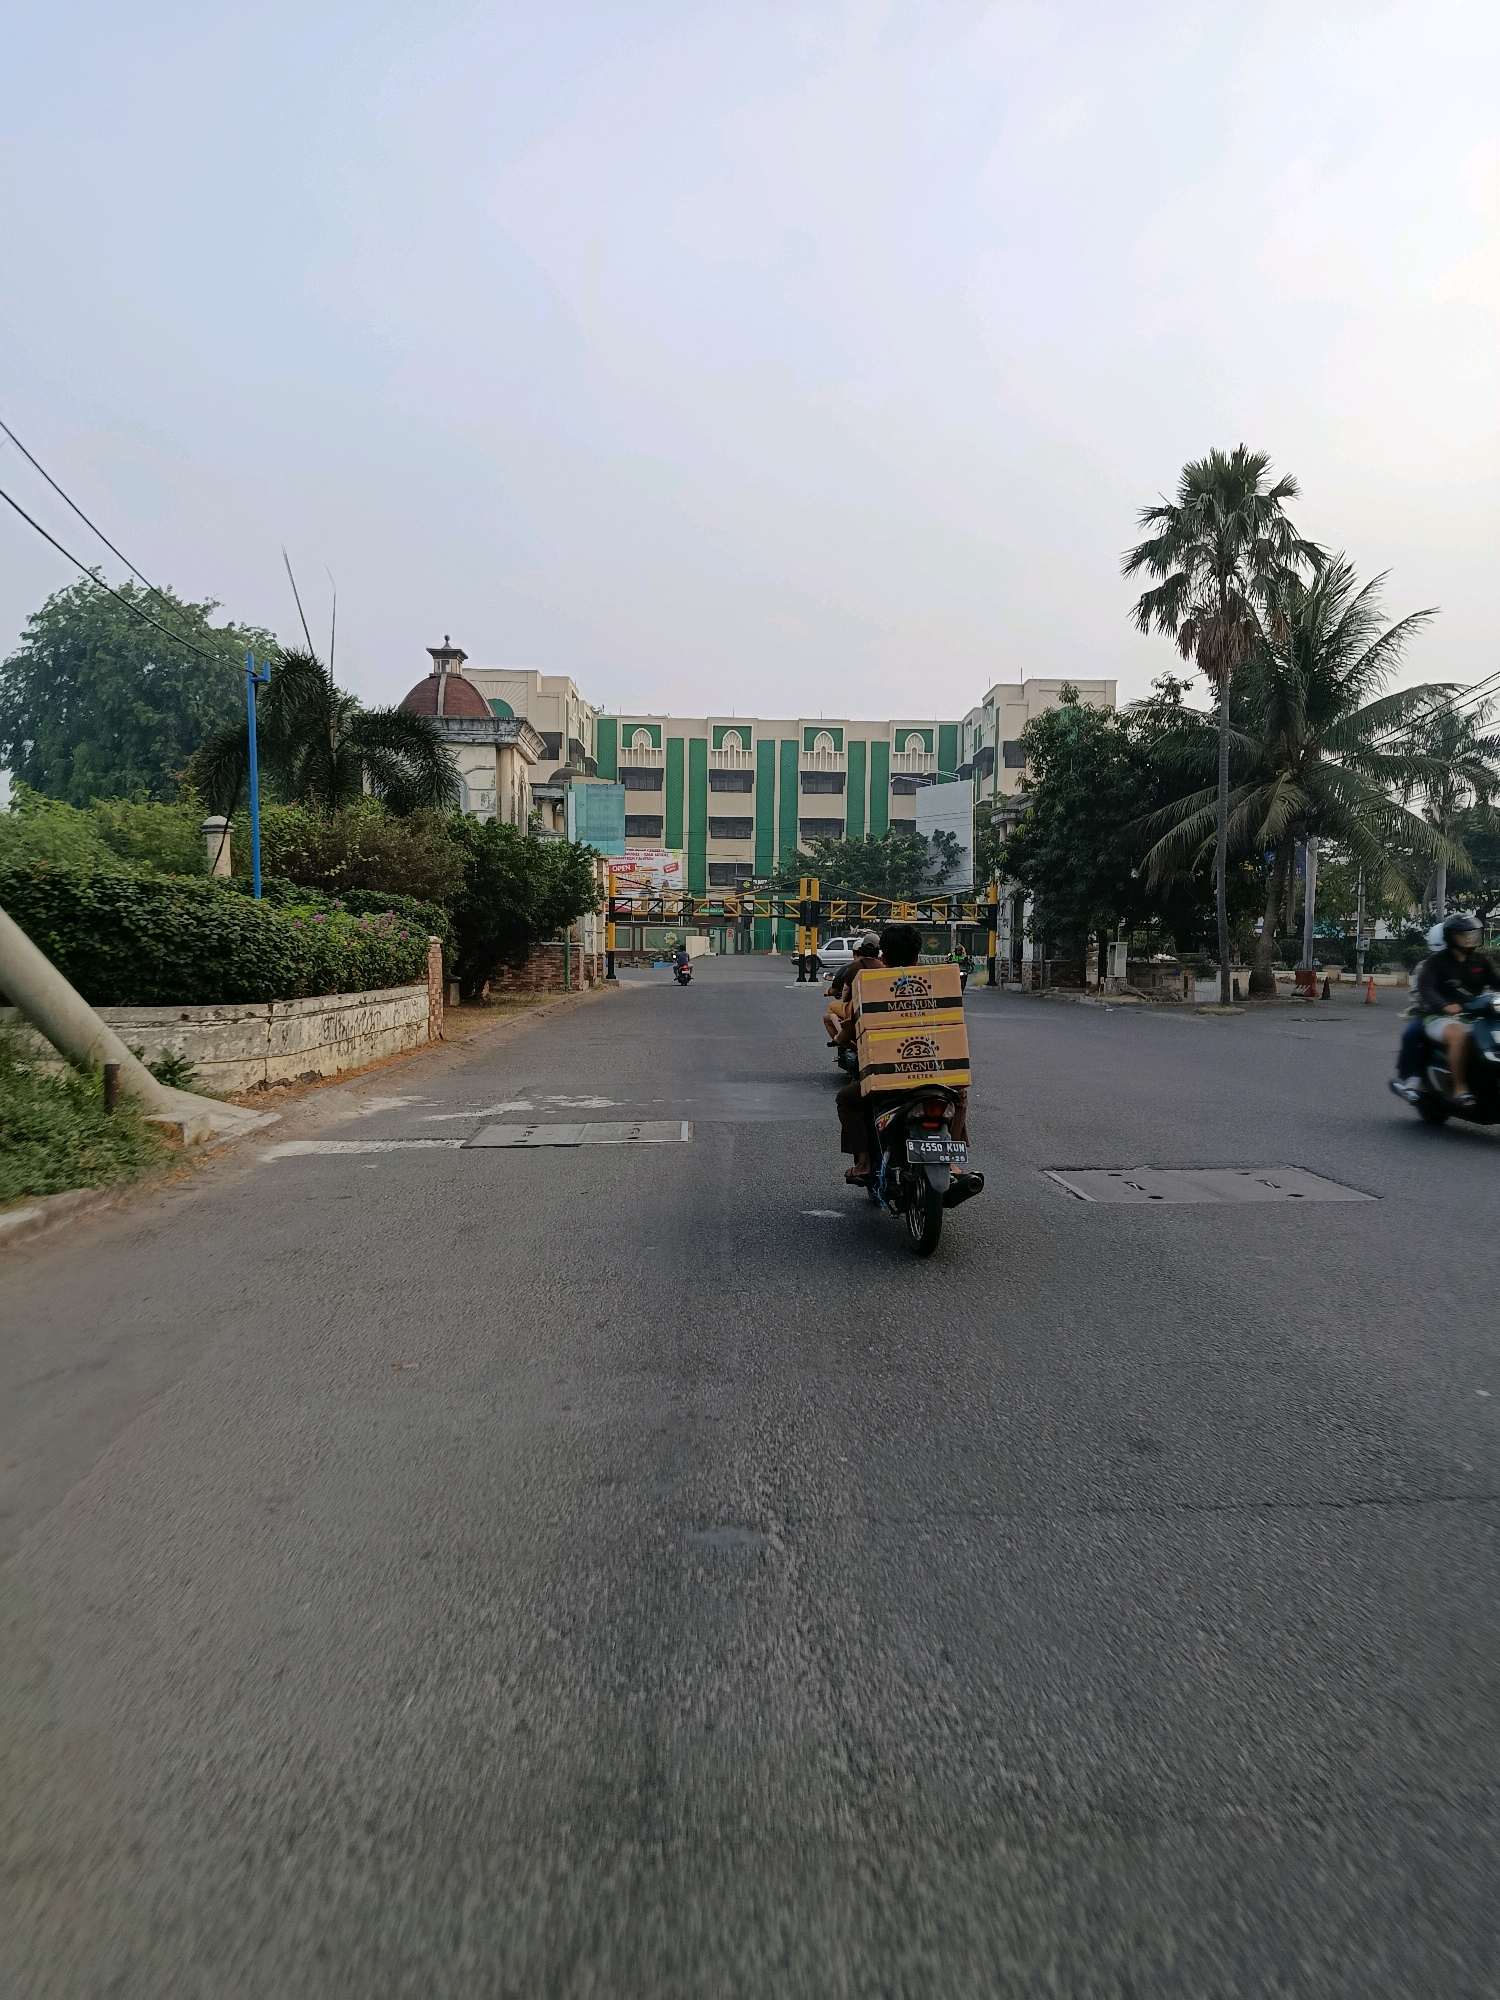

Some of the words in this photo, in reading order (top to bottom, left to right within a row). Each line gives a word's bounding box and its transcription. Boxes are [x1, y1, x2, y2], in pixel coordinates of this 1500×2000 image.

[612, 864, 631, 872] OPEN
[898, 984, 924, 995] 234
[887, 999, 938, 1011] MAGNUM
[905, 1045, 932, 1056] 234
[894, 1060, 945, 1073] MAGNUM
[908, 1141, 914, 1151] B
[920, 1142, 942, 1152] 4550
